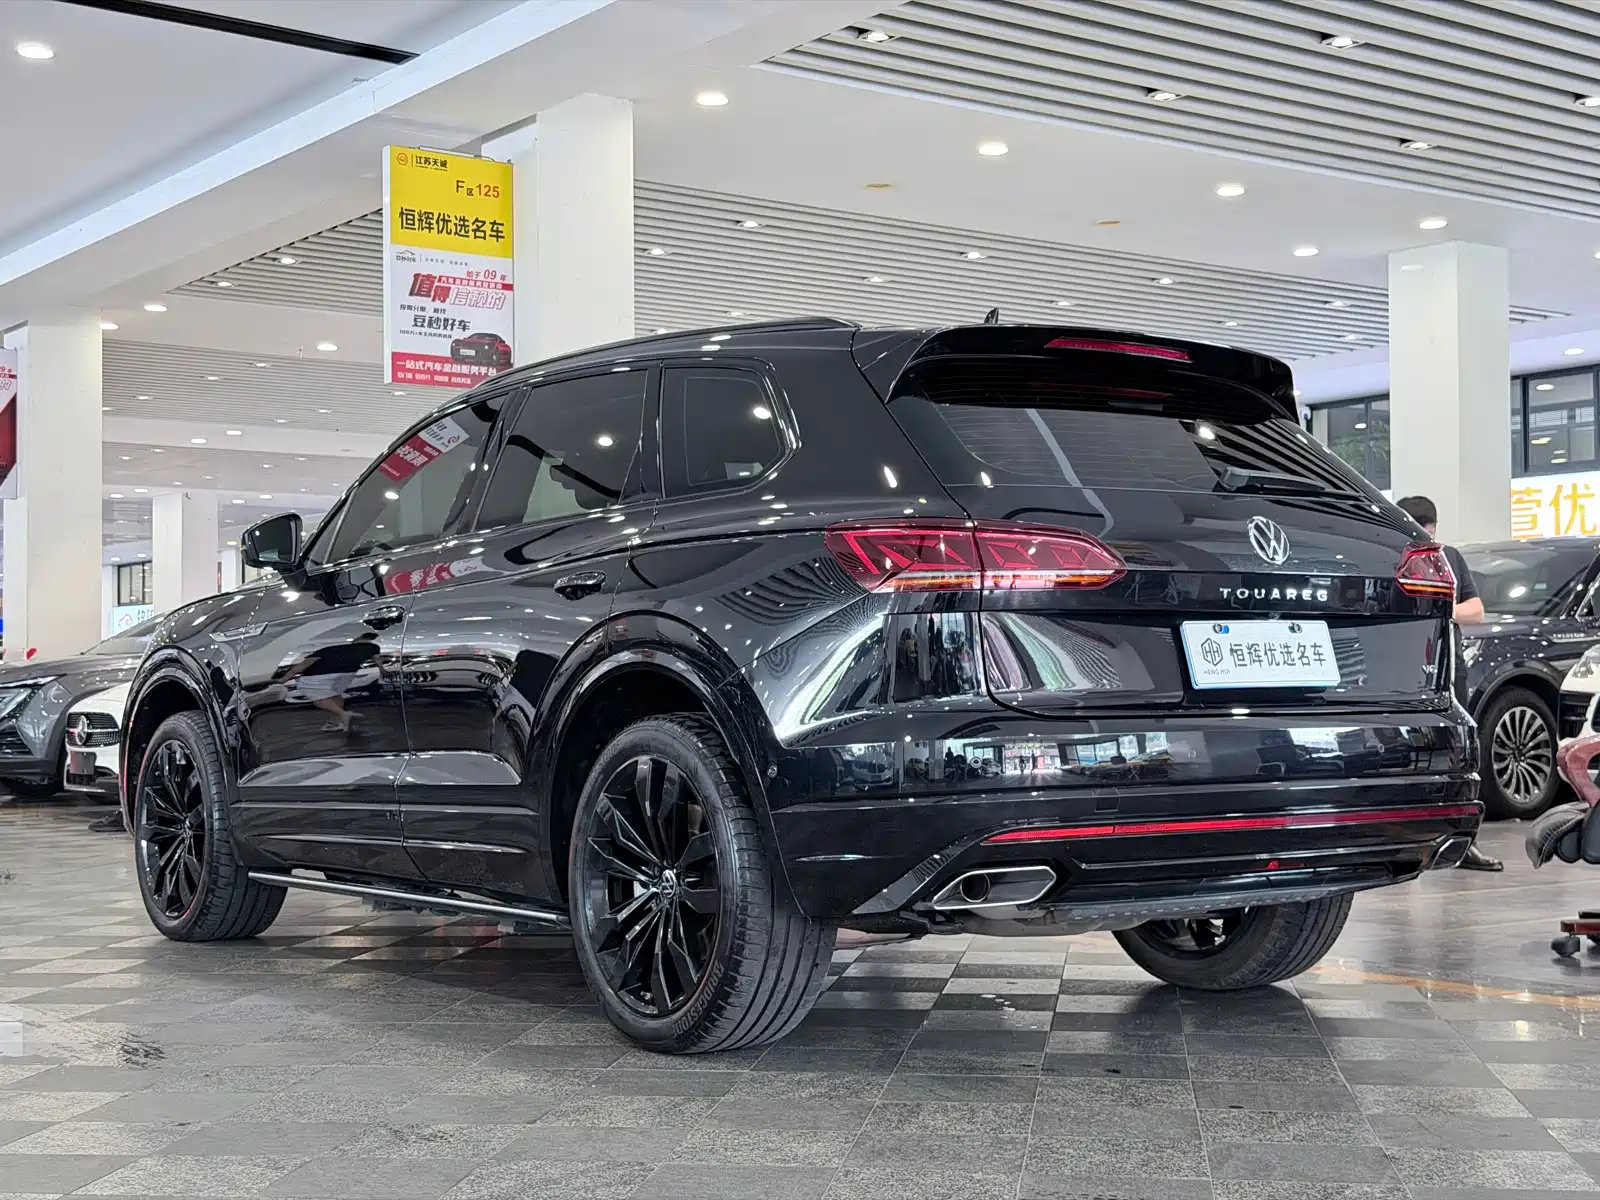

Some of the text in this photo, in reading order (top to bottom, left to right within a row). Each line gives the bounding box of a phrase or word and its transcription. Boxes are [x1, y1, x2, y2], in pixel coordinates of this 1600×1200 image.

[415, 155, 448, 169] 江苏天诚
[399, 206, 505, 243] 恒辉优选名车
[412, 314, 471, 332] 豆秒好车
[1220, 588, 1328, 601] TOUAREG
[1229, 642, 1326, 668] 恒辉优选名车
